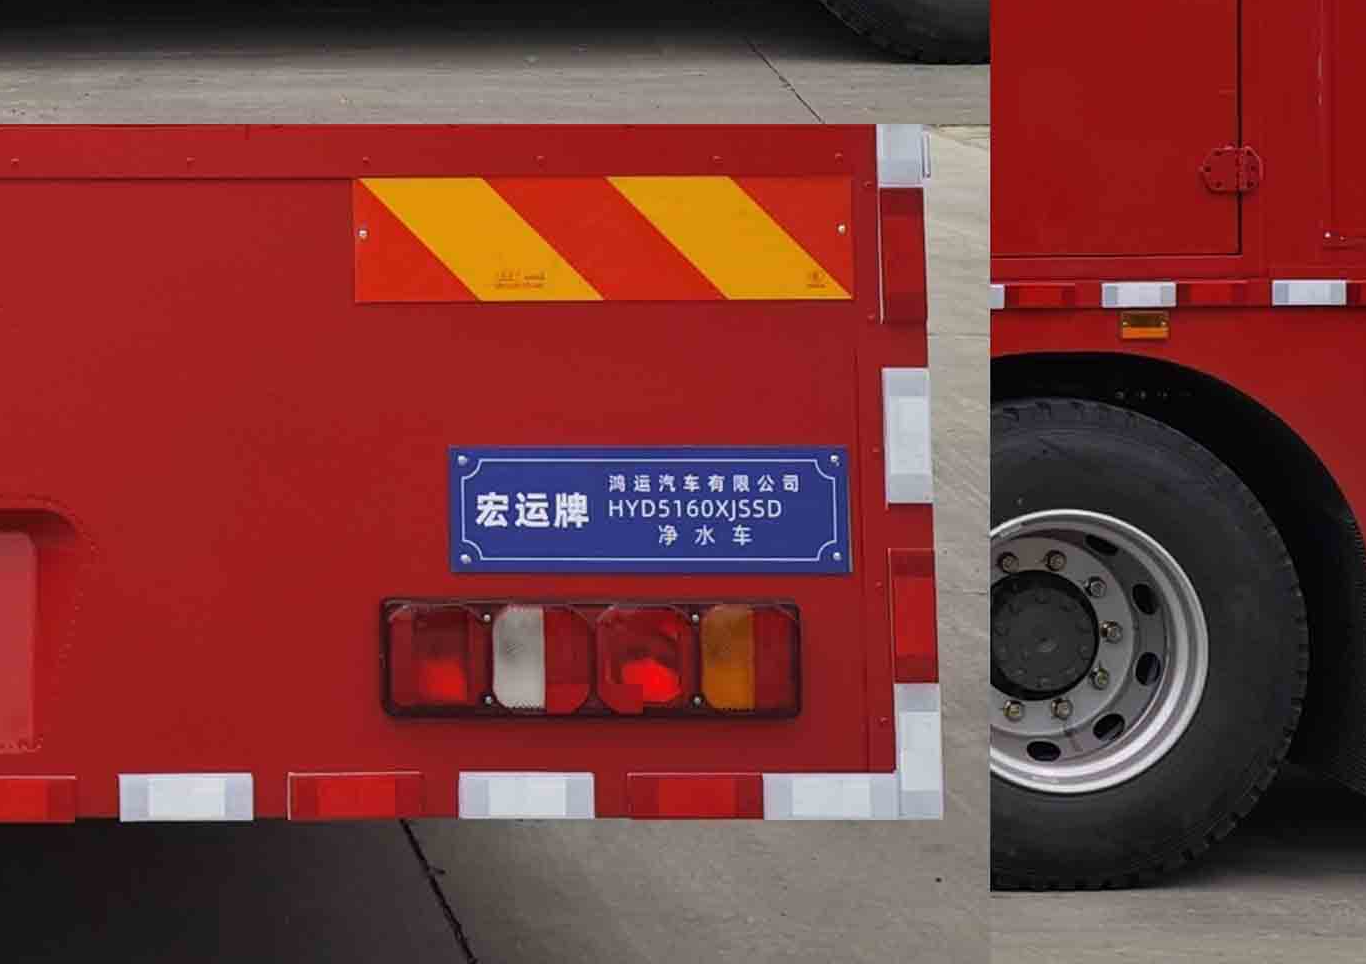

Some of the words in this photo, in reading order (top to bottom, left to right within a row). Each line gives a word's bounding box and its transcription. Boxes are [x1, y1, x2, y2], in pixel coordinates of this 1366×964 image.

[608, 474, 801, 493] 鸿运汽车有限公司
[475, 492, 590, 528] 宏运牌
[608, 499, 782, 520] HYD5160XJSSD
[658, 525, 753, 546] 净水车
